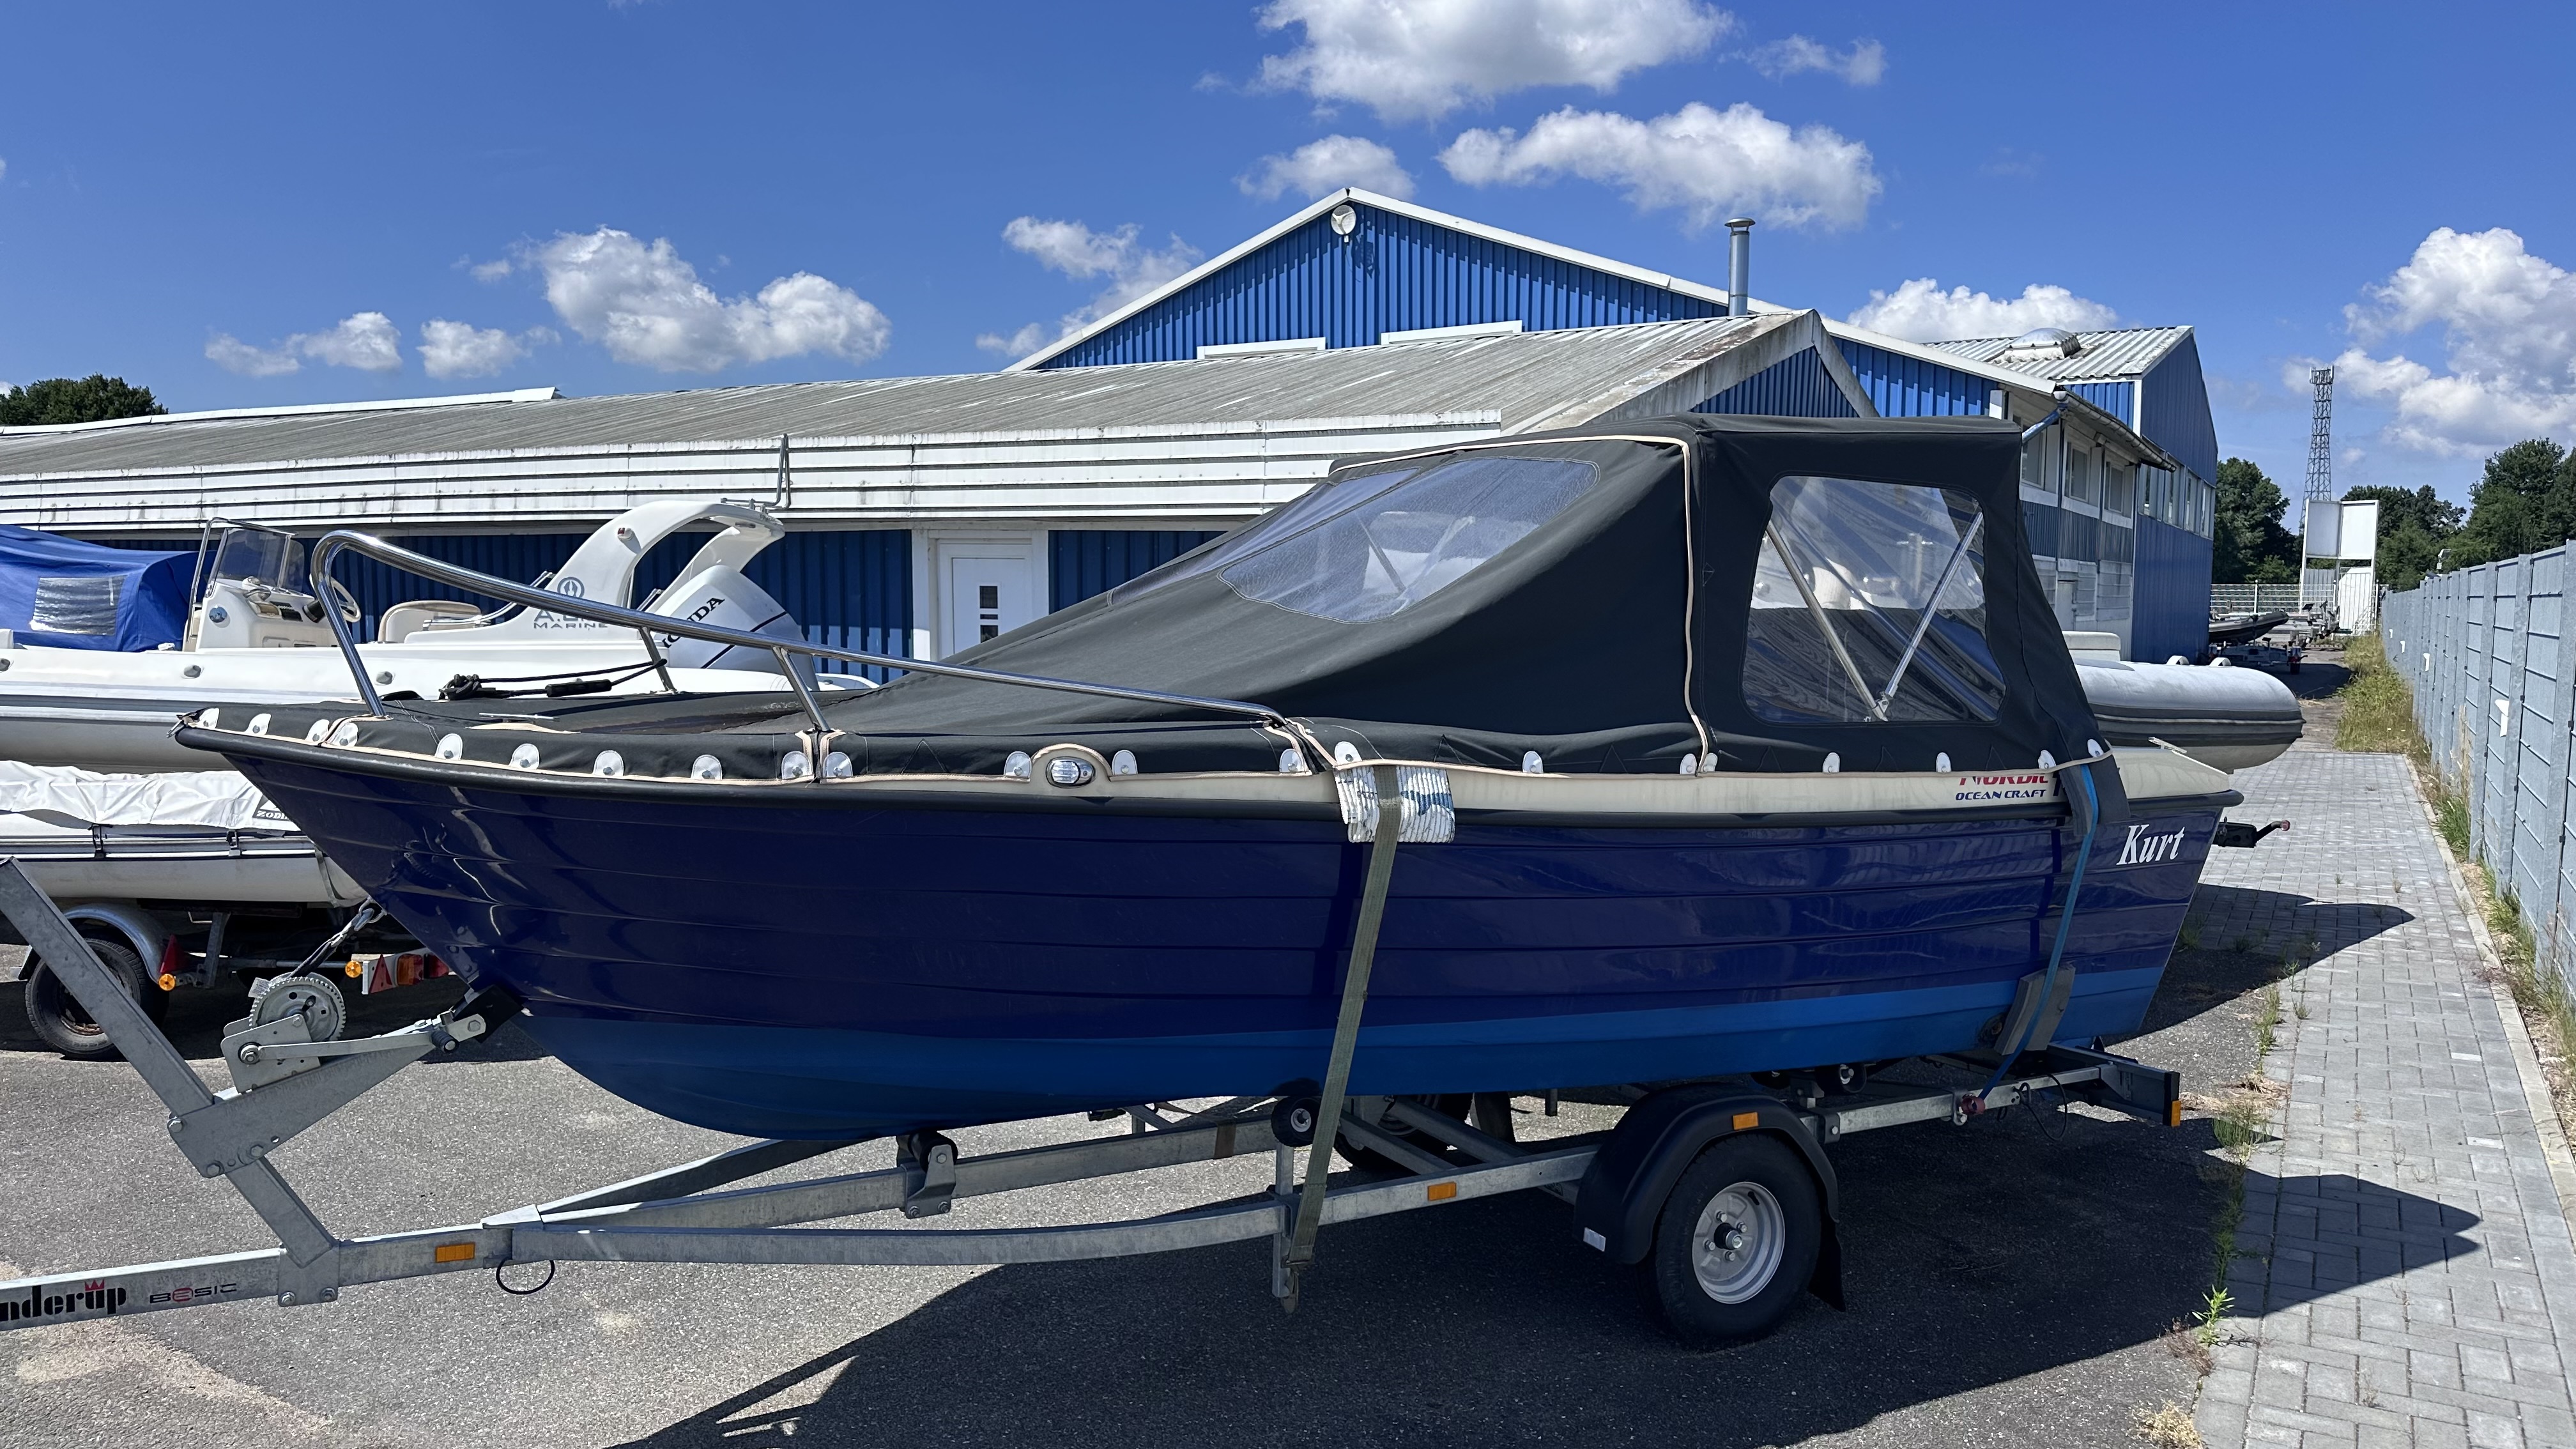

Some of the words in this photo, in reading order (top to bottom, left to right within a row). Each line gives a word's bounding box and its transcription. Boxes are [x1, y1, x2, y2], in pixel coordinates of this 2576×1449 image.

[1955, 790, 2002, 801] OCEAN
[2004, 789, 2046, 799] CRAFT
[256, 810, 288, 820] ZODI
[2115, 824, 2185, 865] Kurt
